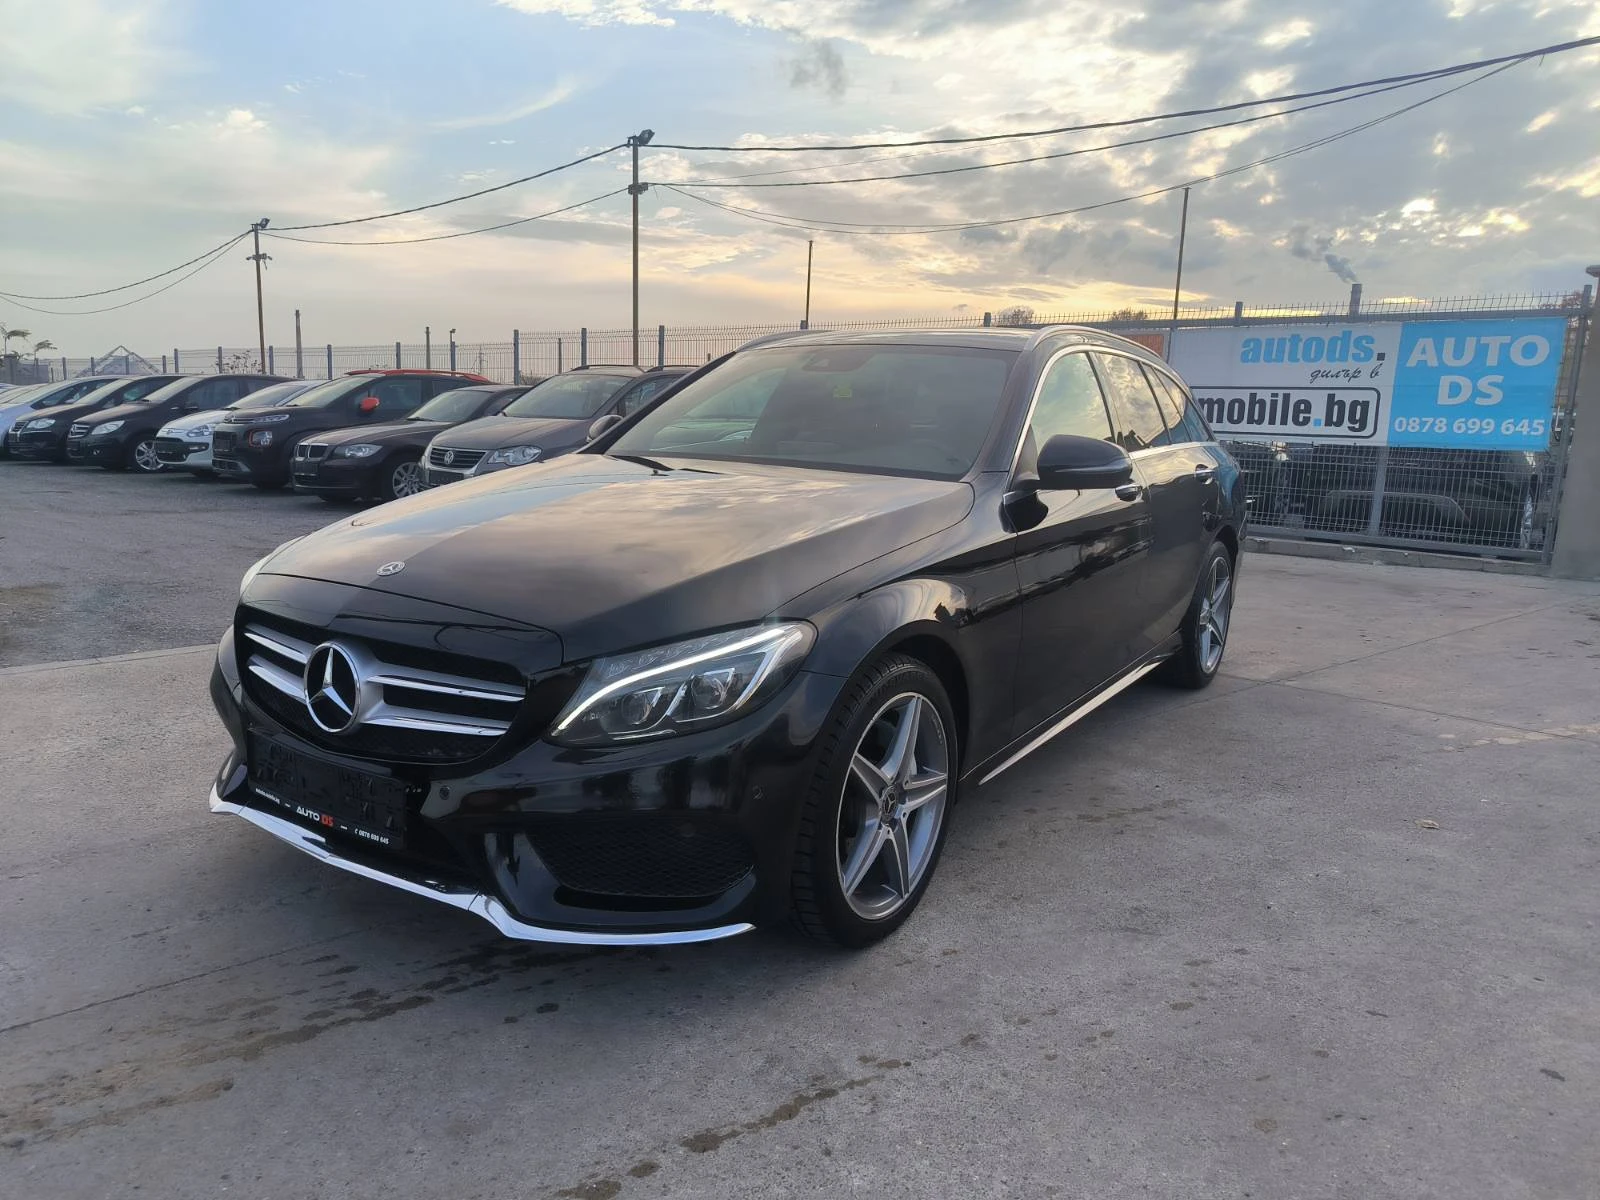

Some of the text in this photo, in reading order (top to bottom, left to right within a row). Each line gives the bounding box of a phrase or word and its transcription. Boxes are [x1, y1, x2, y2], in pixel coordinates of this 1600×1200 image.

[1406, 334, 1550, 368] AUTO
[1309, 368, 1362, 384] дилър
[1437, 375, 1504, 407] DS
[1198, 392, 1370, 433] mobile.bg
[1394, 416, 1545, 436] 0878 699 645
[296, 805, 320, 822] AUTO
